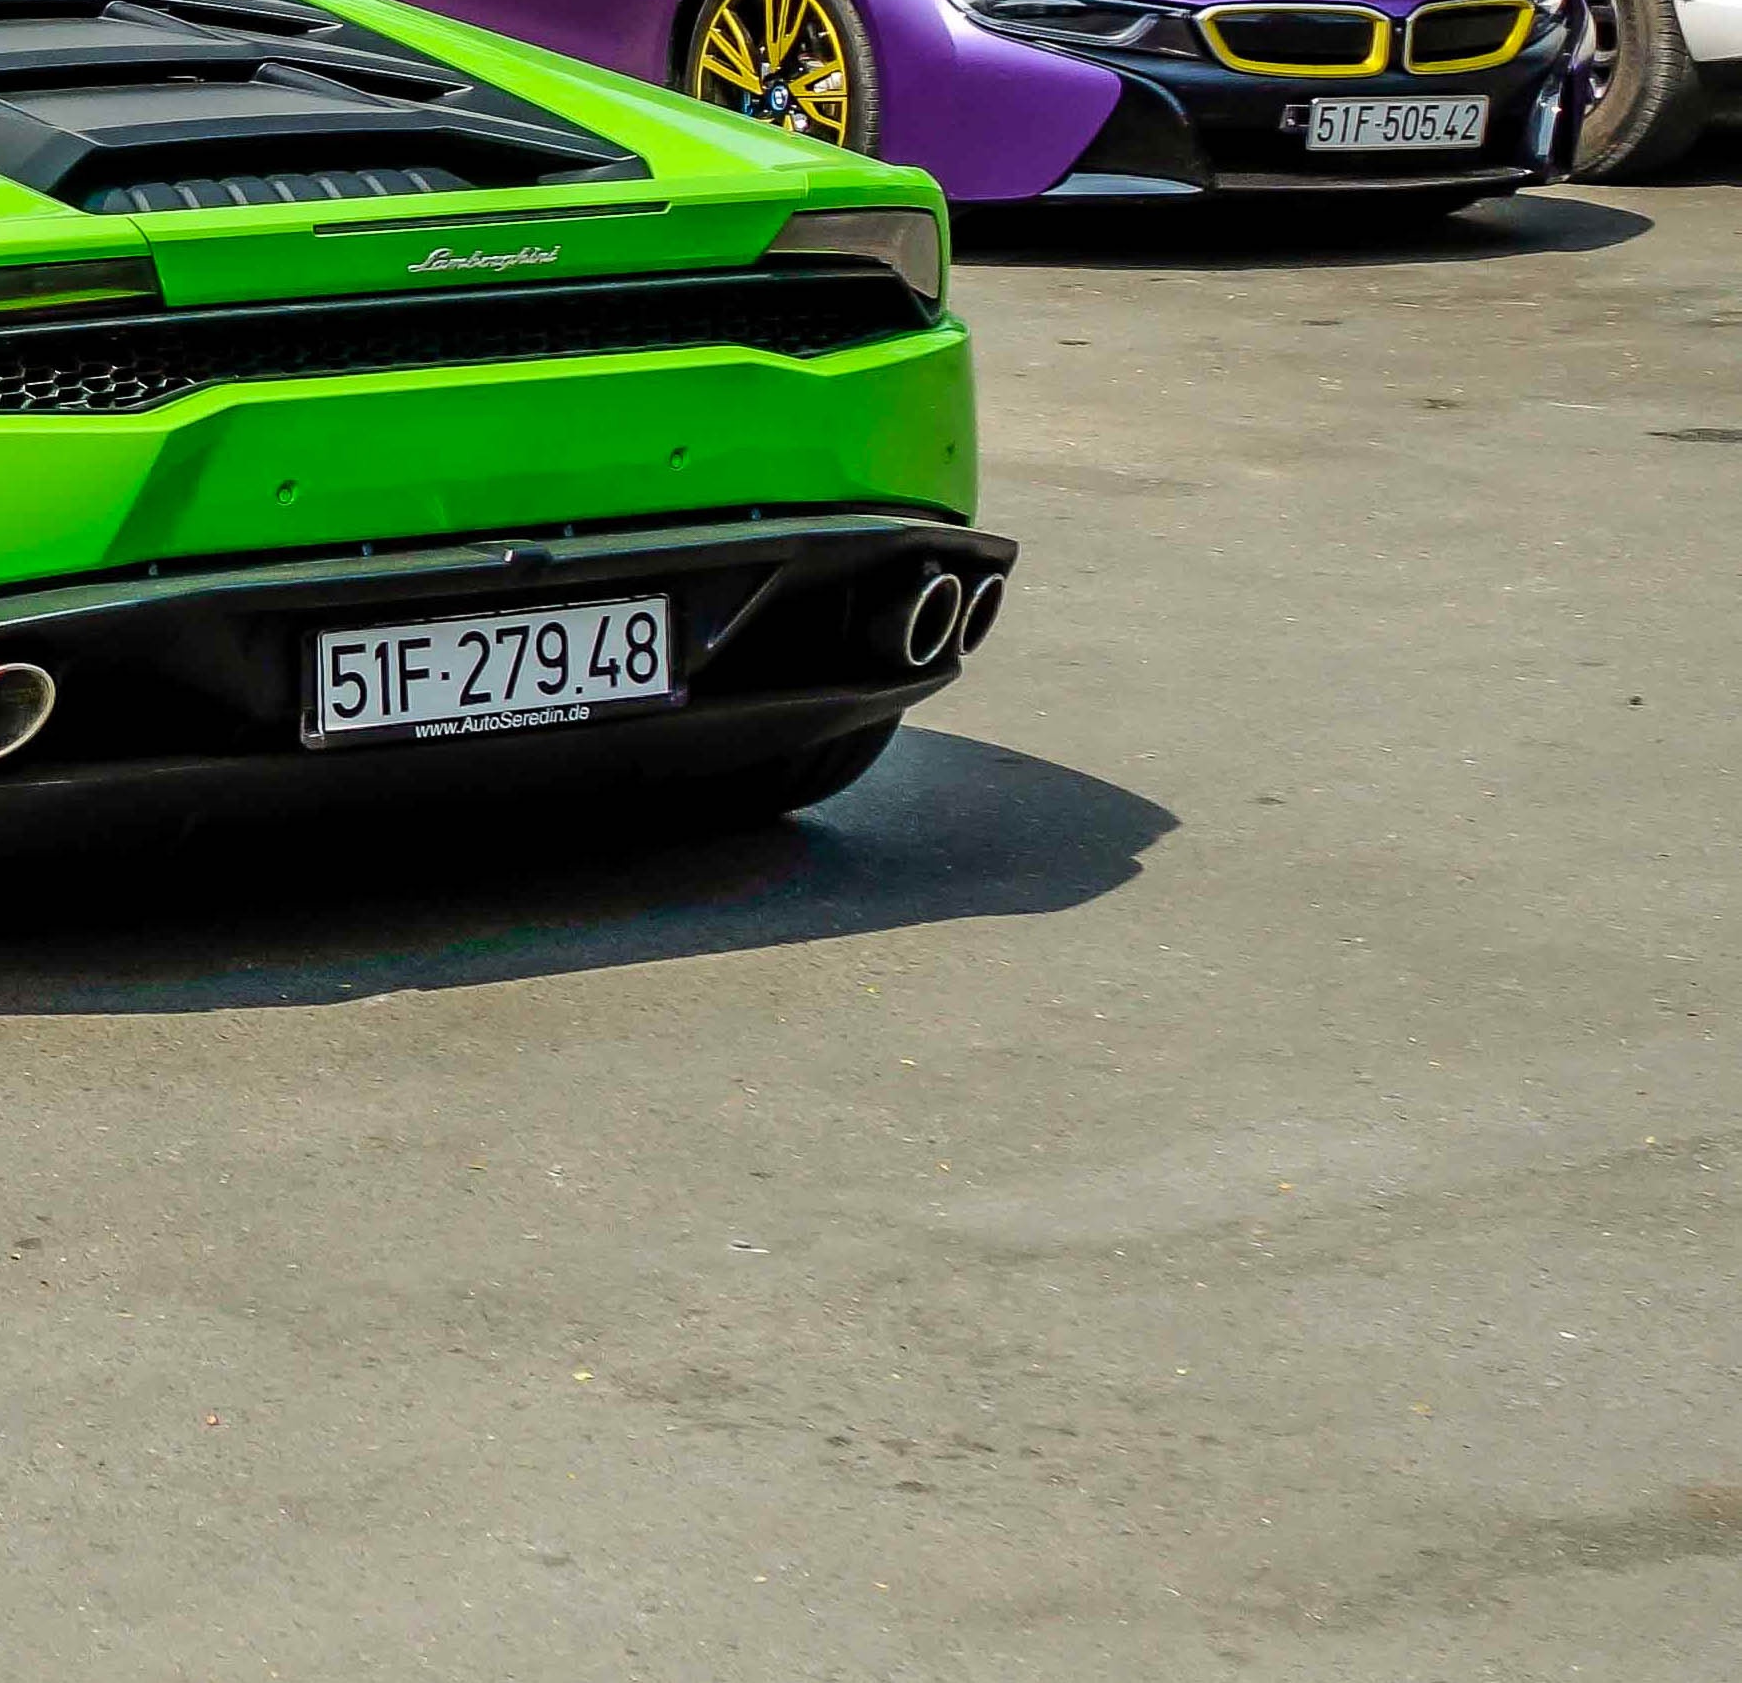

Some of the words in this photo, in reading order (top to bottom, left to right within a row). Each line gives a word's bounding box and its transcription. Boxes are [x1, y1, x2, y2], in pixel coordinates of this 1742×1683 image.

[1317, 103, 1481, 143] 51F-505.42
[407, 244, 562, 273] Lamborghini
[415, 703, 591, 739] www.AutoSeredin.de
